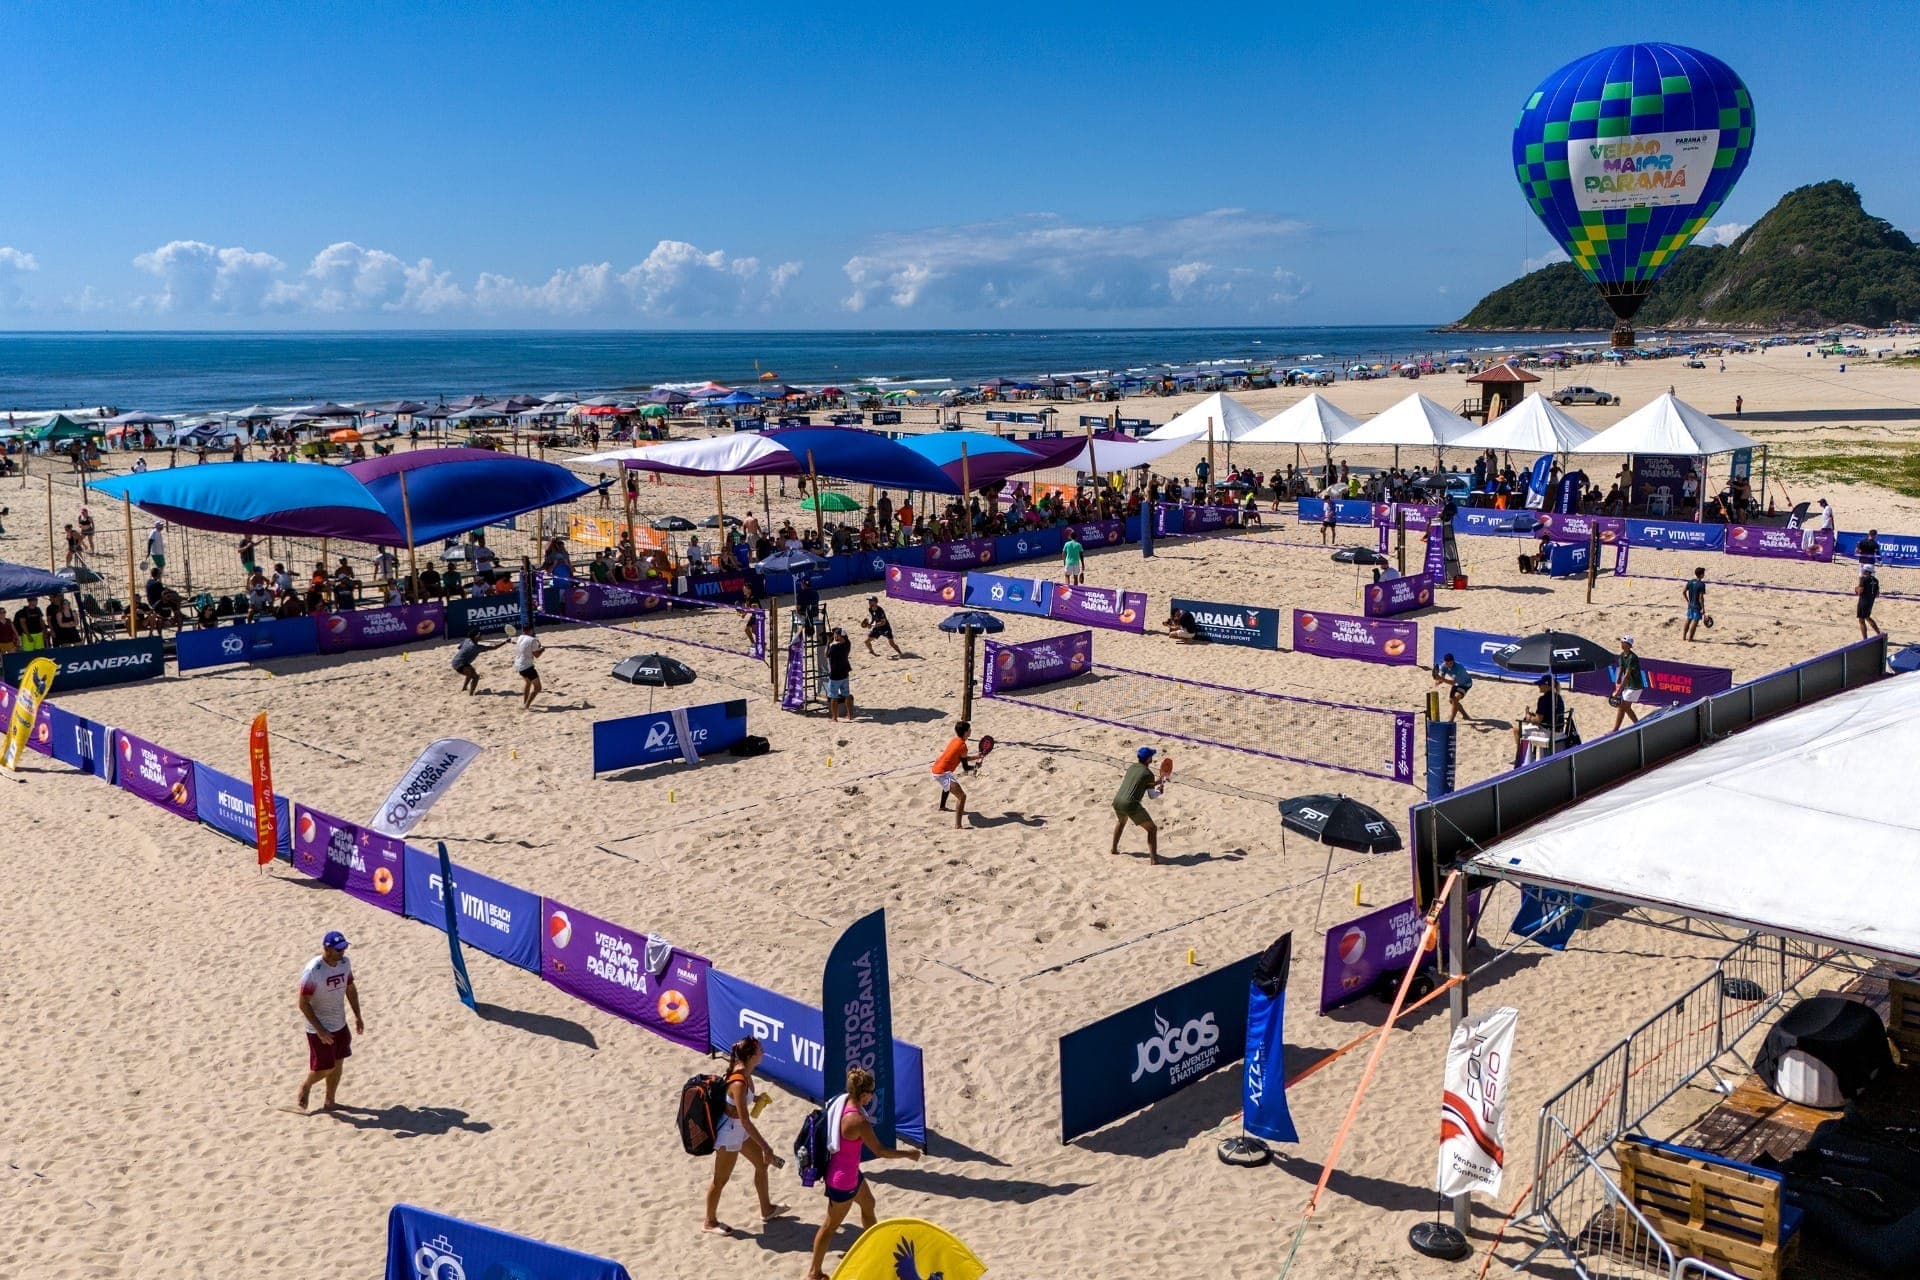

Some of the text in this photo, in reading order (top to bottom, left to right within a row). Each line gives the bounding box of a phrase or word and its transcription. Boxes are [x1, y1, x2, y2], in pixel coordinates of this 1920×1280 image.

[1589, 137, 1660, 159] VERÃO
[1604, 153, 1674, 173] MAIOR
[1584, 164, 1686, 193] PARANÁ
[1467, 514, 1486, 524] FPT
[1644, 526, 1687, 540] FPT VITA
[1877, 540, 1918, 552] TODO VITA
[467, 602, 520, 620] PARAN
[1332, 631, 1375, 645] PARANÁ
[66, 653, 152, 674] SANEPAR
[1553, 648, 1580, 660] FPT
[638, 667, 661, 676] FPT
[1657, 672, 1692, 685] BEACH
[1658, 682, 1692, 694] SPORTS
[75, 725, 93, 760] FIAT
[644, 721, 708, 750] Azre
[401, 764, 434, 802] PORTOS
[408, 752, 458, 809] DO PARANÁ
[218, 790, 243, 813] MÉTODO
[219, 808, 256, 830] BEACHTENNI
[1298, 806, 1329, 822] FPT
[329, 826, 354, 843] VERÃO
[1364, 821, 1385, 836] FPT
[335, 839, 359, 856] MAIOR
[328, 846, 366, 872] PARANÁ
[460, 892, 484, 922] VITA
[489, 905, 511, 923] BEACH
[490, 918, 510, 934] SPORTS
[594, 931, 632, 957] VERÃO
[1385, 933, 1419, 960] PARA
[600, 946, 638, 972] MAIOR
[326, 973, 345, 988] FPT
[586, 955, 648, 995] PARANÁ
[852, 950, 876, 1049] PARANÁ
[739, 1007, 784, 1043] FPT
[845, 1000, 862, 1072] ORTOS
[1131, 1012, 1220, 1083] JOGOS
[1169, 1045, 1220, 1076] DE AVENTURA
[1170, 1058, 1216, 1086] & NATUREZA
[1482, 1051, 1501, 1125] FISIO
[1453, 1152, 1477, 1169] Venha
